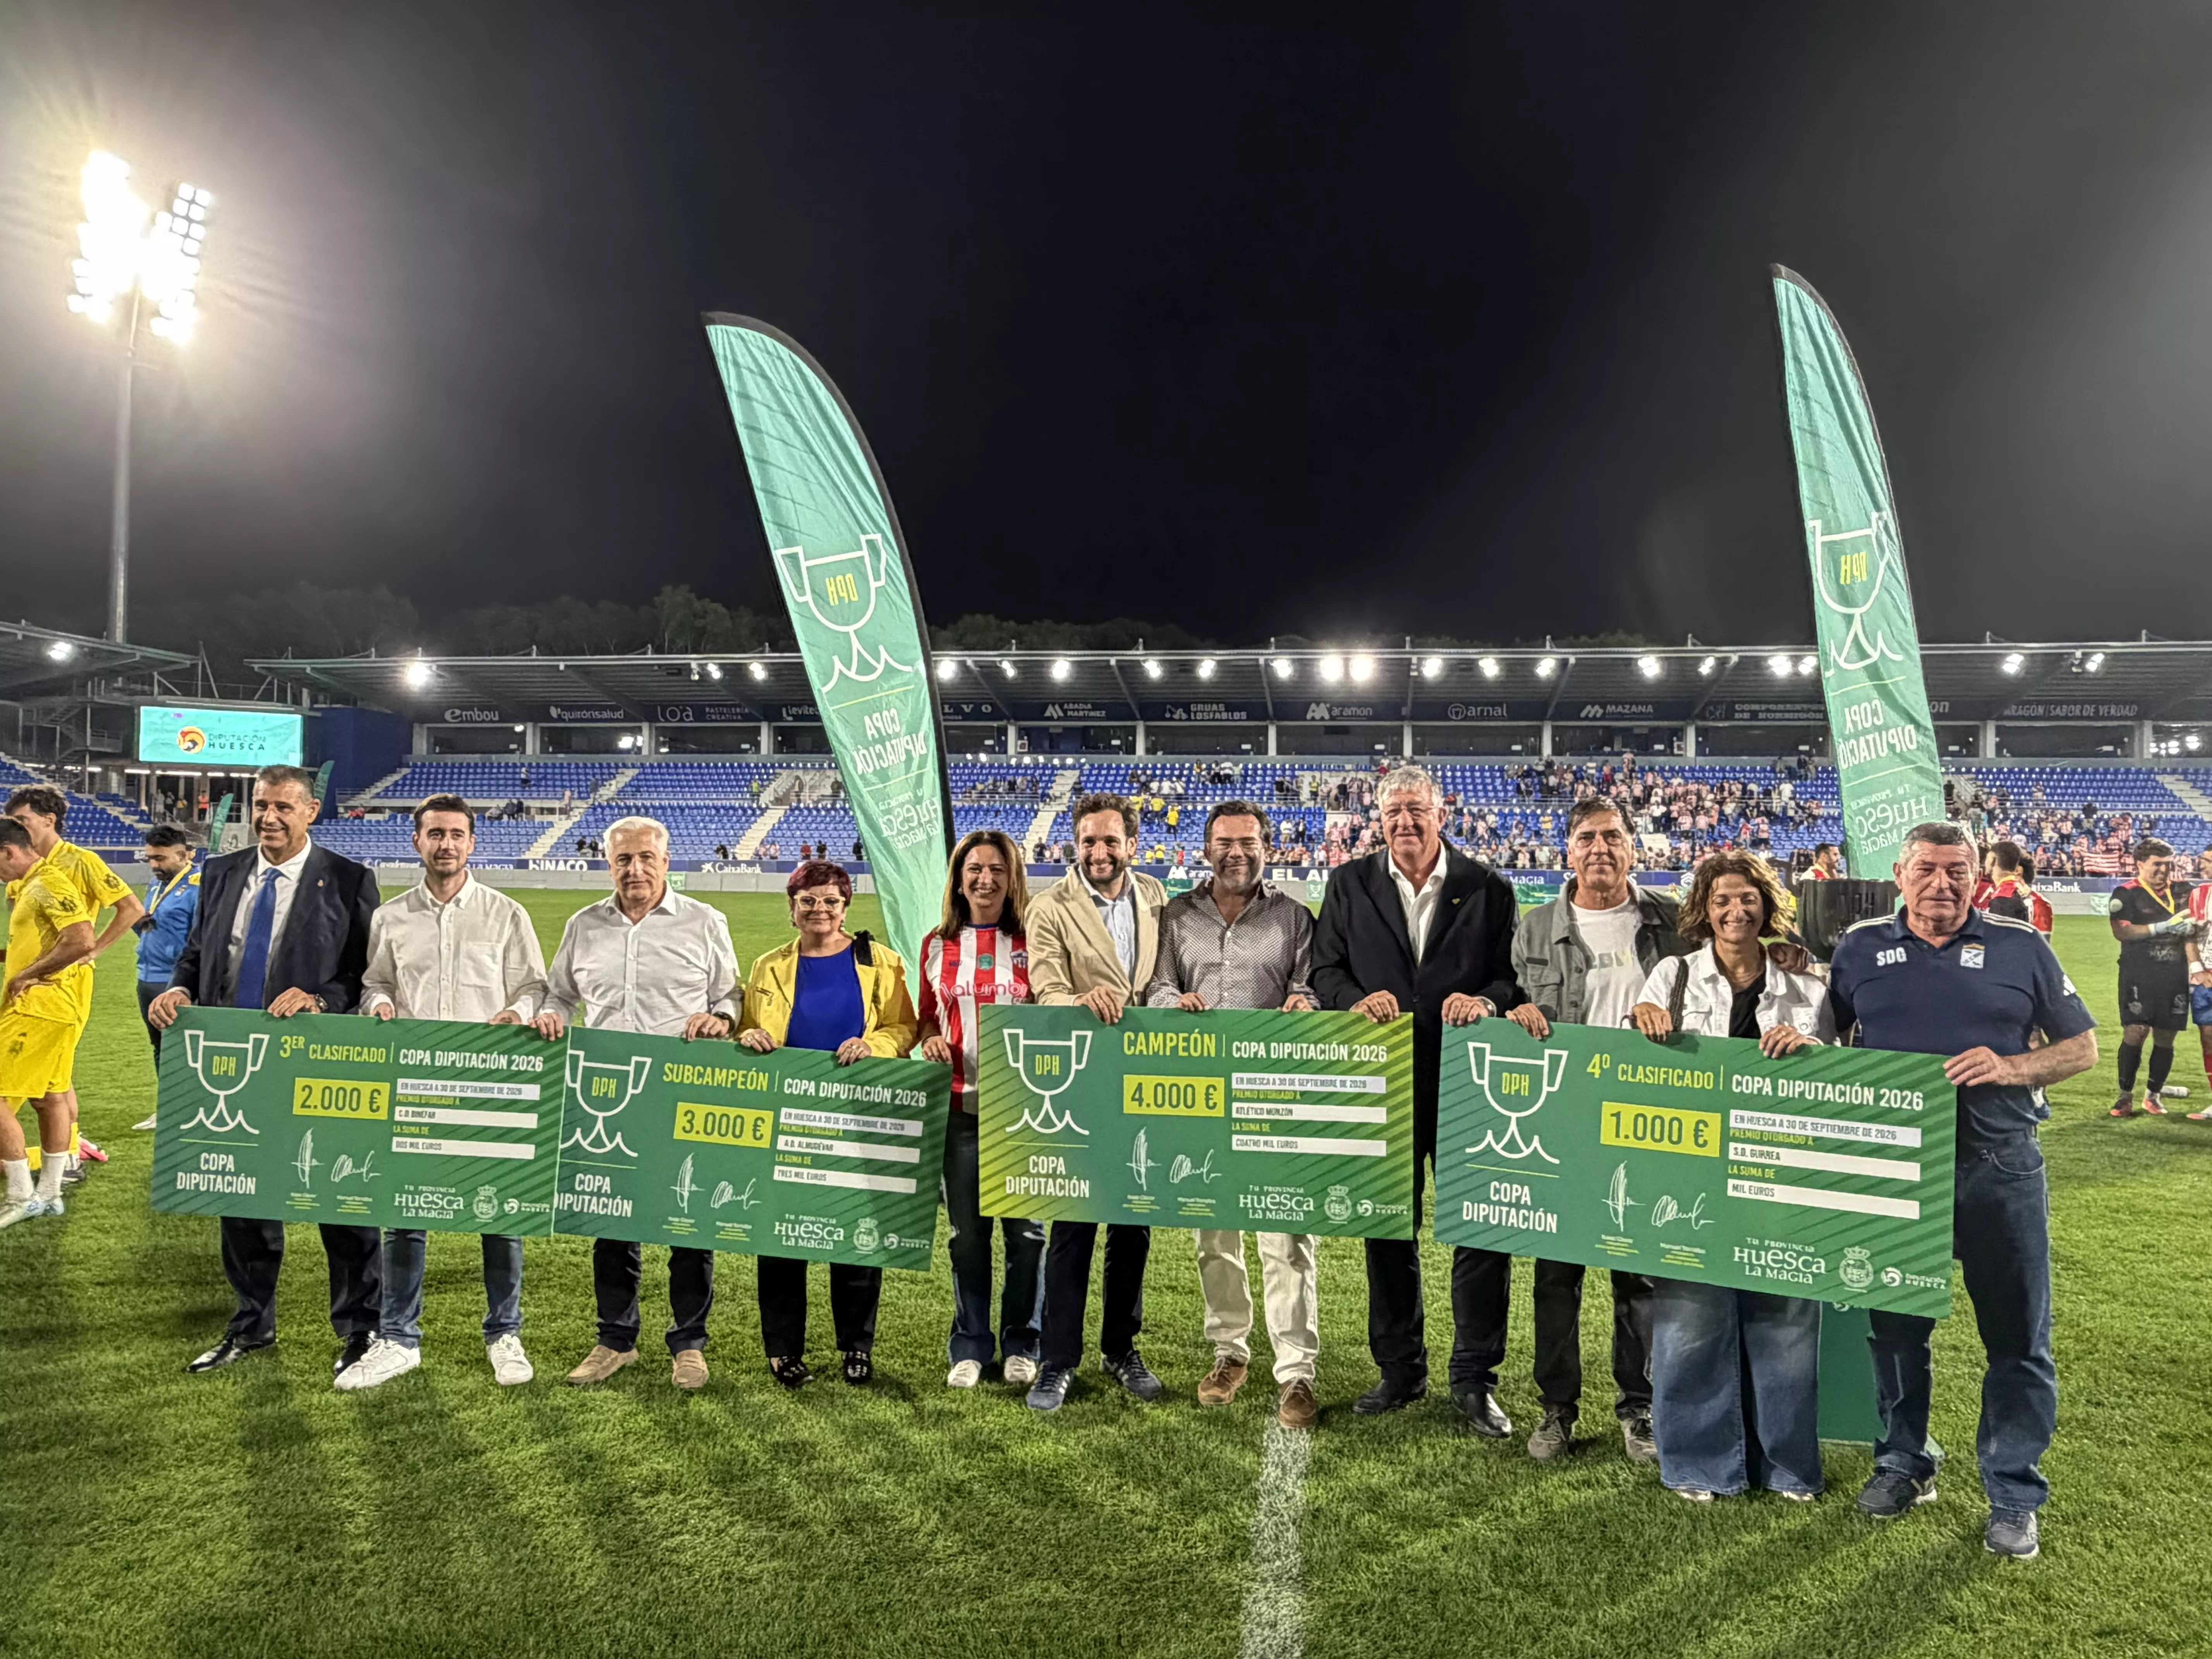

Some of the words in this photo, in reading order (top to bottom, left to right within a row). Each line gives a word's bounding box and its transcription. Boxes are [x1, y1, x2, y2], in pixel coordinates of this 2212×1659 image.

[444, 707, 500, 722] embou
[560, 708, 624, 722] quirónsalud
[1331, 706, 1372, 716] aramon
[1467, 704, 1507, 716] arnal
[1606, 704, 1653, 713] MAZANA
[2049, 705, 2080, 716] SABOR
[2082, 705, 2095, 716] DE
[2099, 705, 2138, 716] VERDAD
[208, 742, 265, 750] HUESCA
[715, 862, 763, 874] CaixaBank
[1188, 868, 1214, 878] aram
[1272, 868, 1300, 881] EL
[2031, 881, 2082, 893] aixaBank
[1876, 946, 1908, 967] SDG
[309, 1044, 386, 1063] CLASIFICADO
[1123, 1029, 1216, 1058] CAMPEÓN
[1232, 1041, 1266, 1059] COPA
[1271, 1041, 1348, 1060] DIPUTACIÓN
[1352, 1044, 1387, 1063] 2026
[212, 1056, 236, 1077] DPH
[399, 1049, 431, 1066] COPA
[435, 1051, 507, 1070] DIPUTACIÓN
[510, 1055, 543, 1072] 2026
[1035, 1055, 1060, 1075] DPH
[663, 1063, 769, 1091] SUBCAMPEÓN
[1246, 1077, 1270, 1086] HUESCA
[1272, 1078, 1276, 1086] A
[1288, 1078, 1296, 1086] DE
[1502, 1072, 1530, 1096] DPH
[1618, 1064, 1714, 1090] CLASIFICADO
[592, 1077, 617, 1098] DPH
[784, 1078, 816, 1096] COPA
[819, 1082, 891, 1104] DIPUTACIÓN
[894, 1089, 927, 1107] 2026
[1131, 1082, 1196, 1109] 4.000
[1204, 1084, 1218, 1110] €
[1732, 1074, 1773, 1096] COPA
[1778, 1079, 1874, 1105] DIPUTACIÓN
[1879, 1089, 1923, 1111] 2026
[300, 1085, 361, 1112] 2.000
[369, 1089, 381, 1113] €
[682, 1109, 745, 1139] 3.000
[752, 1117, 765, 1141] €
[1232, 1123, 1240, 1131] LA
[1610, 1111, 1683, 1145] 1.000
[1693, 1119, 1709, 1149] €
[1735, 1115, 1745, 1124] EN
[1747, 1115, 1777, 1127] HUESCA
[1779, 1118, 1785, 1127] A
[1786, 1119, 1797, 1129] 30
[1799, 1121, 1808, 1131] DE
[1810, 1122, 1860, 1137] SEPTIEMBRE
[1862, 1127, 1872, 1137] DE
[1875, 1128, 1897, 1140] 2026
[1730, 1127, 1760, 1139] PREMIO
[1807, 1136, 1814, 1146] A
[200, 1152, 235, 1172] COPA
[1733, 1147, 1748, 1158] S.D.
[1750, 1148, 1781, 1161] GURREA
[1029, 1155, 1066, 1175] COPA
[1728, 1164, 1738, 1174] LA
[1740, 1165, 1763, 1177] SUMA
[1765, 1169, 1776, 1179] DE
[177, 1171, 256, 1195] DIPUTACIÓN
[575, 1173, 611, 1194] COPA
[1006, 1176, 1089, 1198] DIPUTACIÓN
[1732, 1183, 1746, 1194] MIL
[1748, 1185, 1775, 1197] EUROS
[1490, 1181, 1531, 1206] COPA
[1463, 1201, 1557, 1233] DIPUTACIÓN
